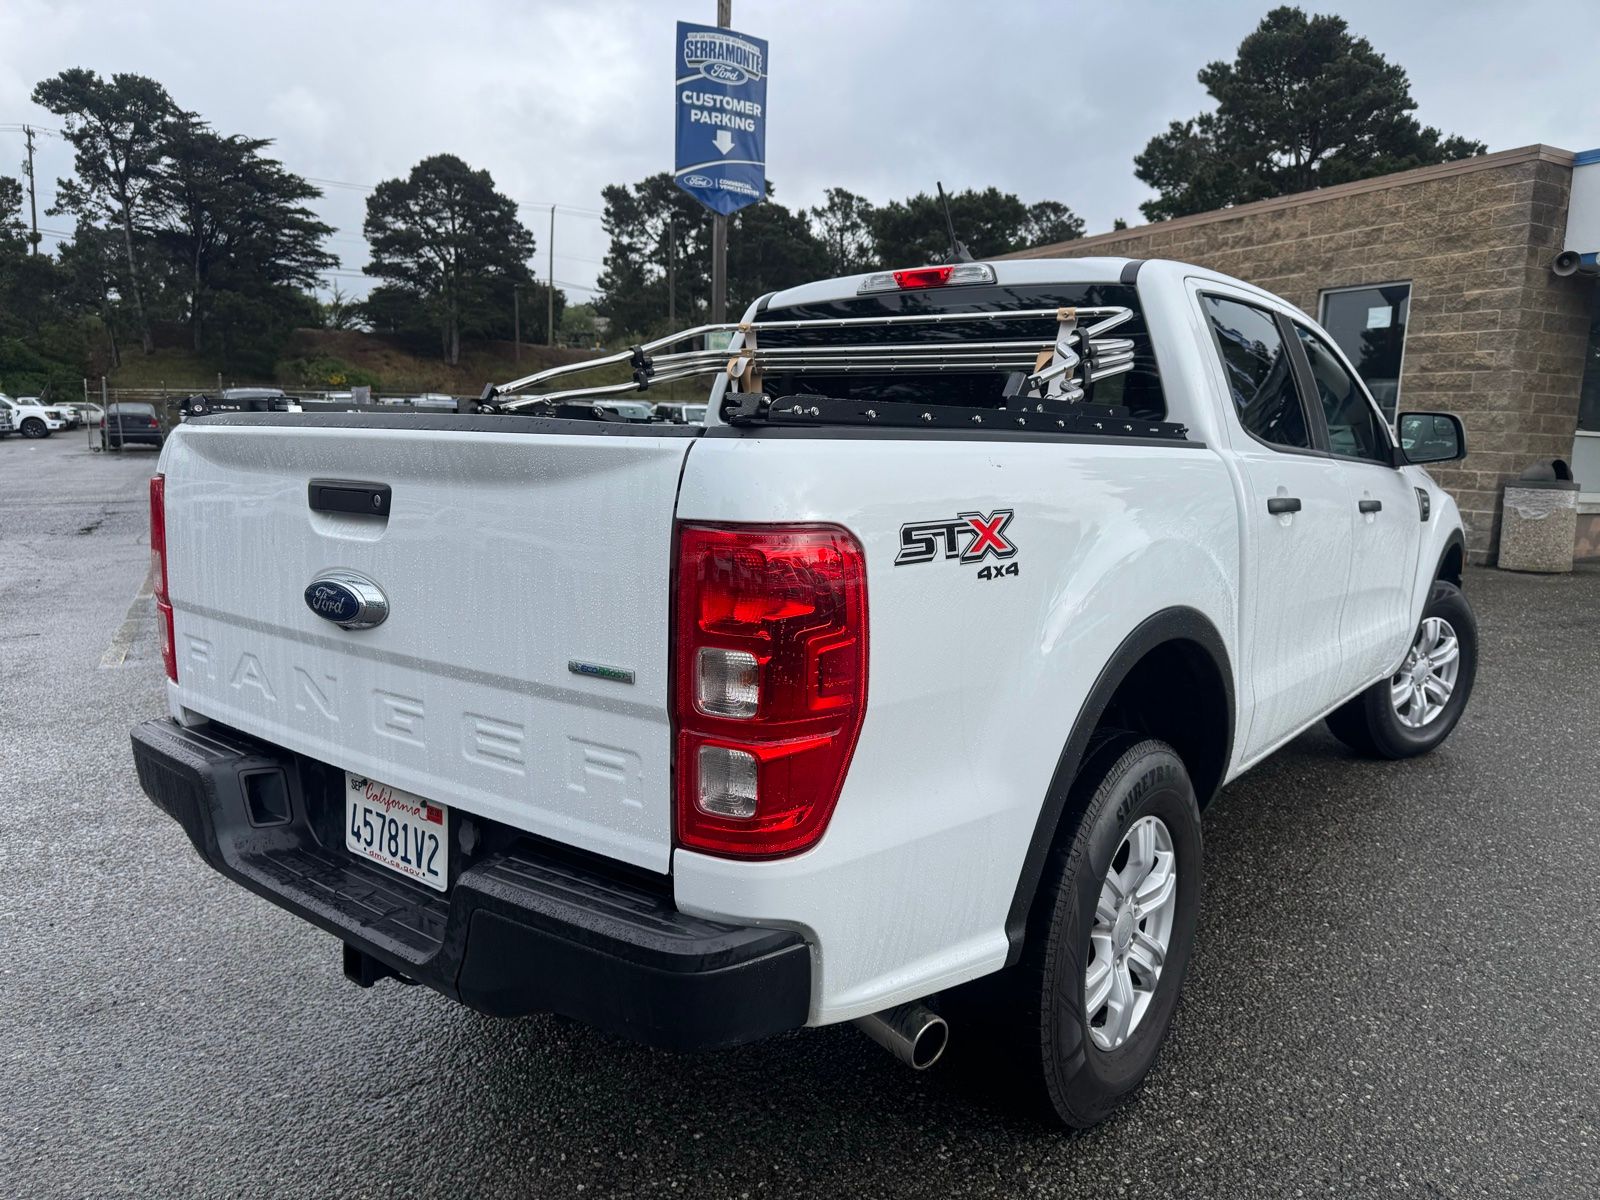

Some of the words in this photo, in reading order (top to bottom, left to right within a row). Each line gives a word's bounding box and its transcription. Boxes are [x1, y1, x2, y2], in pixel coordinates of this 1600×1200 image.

[685, 39, 760, 72] SERRAMONTE
[711, 64, 738, 80] Ford
[681, 90, 761, 117] CUSTOMER
[690, 109, 755, 132] PARKING
[894, 509, 1018, 566] STX
[312, 586, 345, 614] Ford
[183, 632, 644, 808] RANGER
[365, 782, 421, 817] California
[351, 803, 439, 876] 45781V2
[369, 850, 420, 877] dmv.ca.gov
